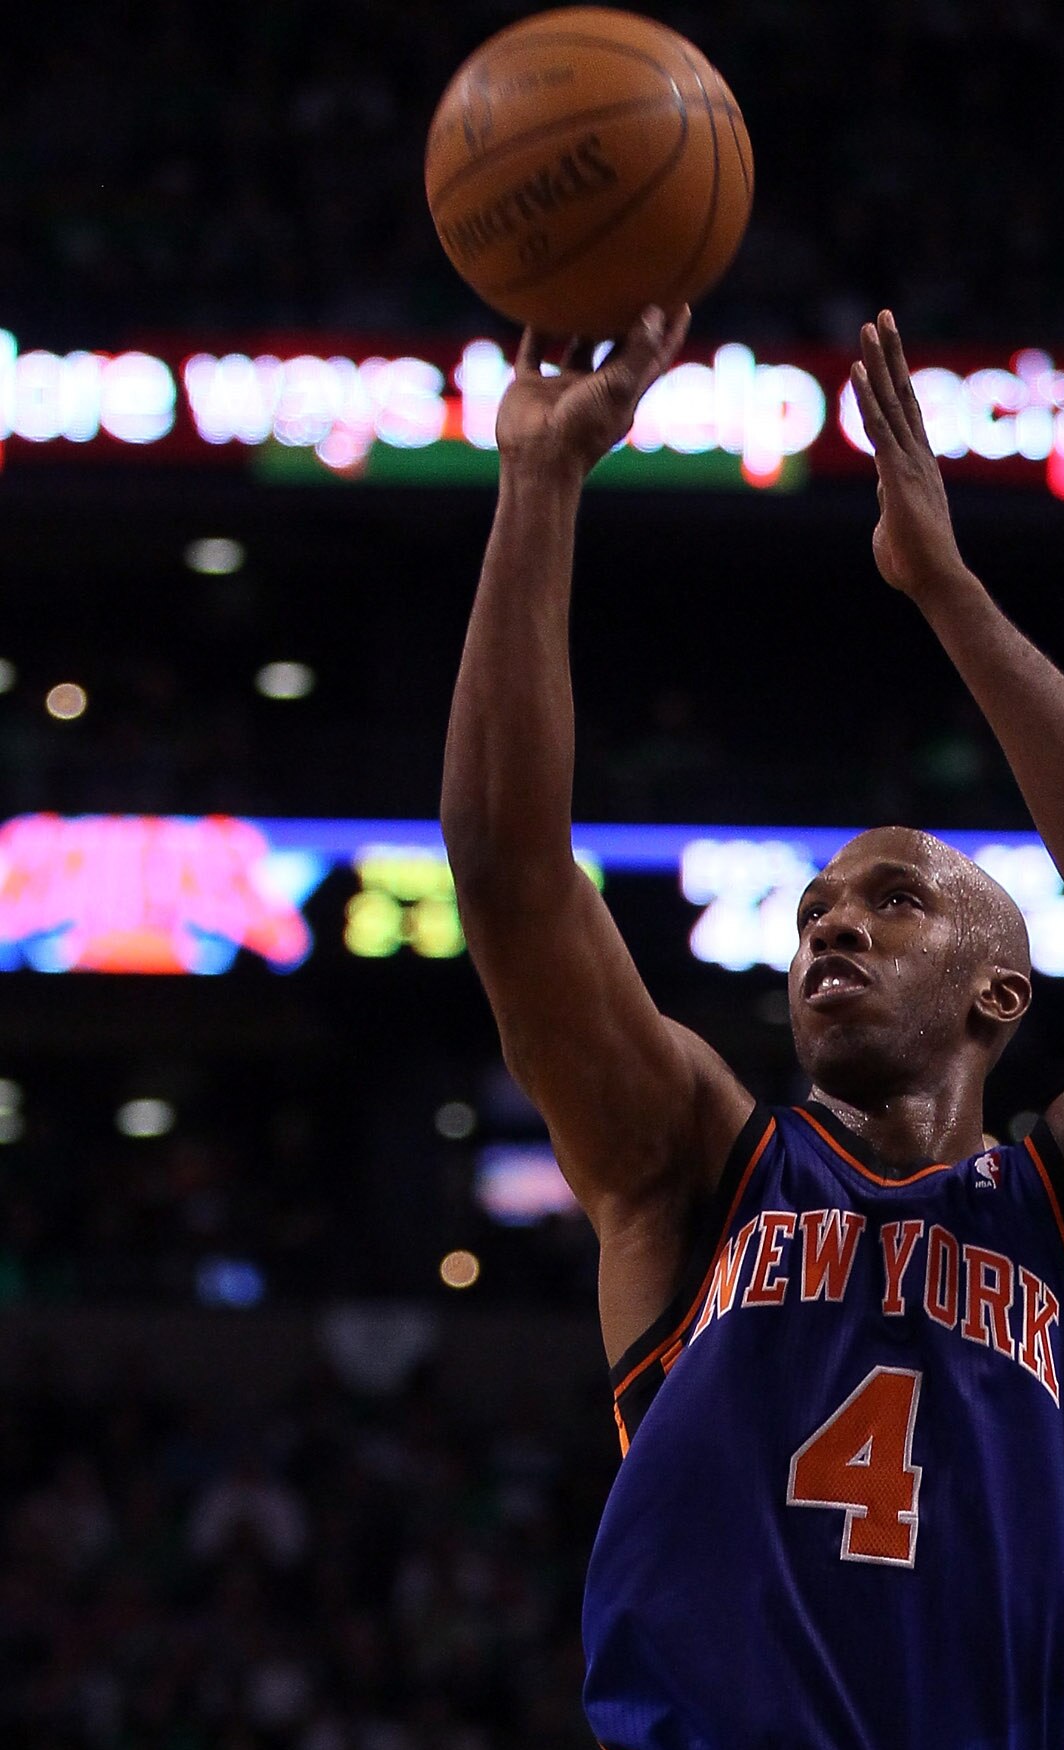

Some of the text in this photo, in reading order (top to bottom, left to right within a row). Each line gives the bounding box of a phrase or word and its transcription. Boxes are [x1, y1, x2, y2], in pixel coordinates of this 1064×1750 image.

[184, 352, 446, 467] ways
[689, 1209, 1060, 1409] NEW YORK
[786, 1365, 923, 1569] 4
